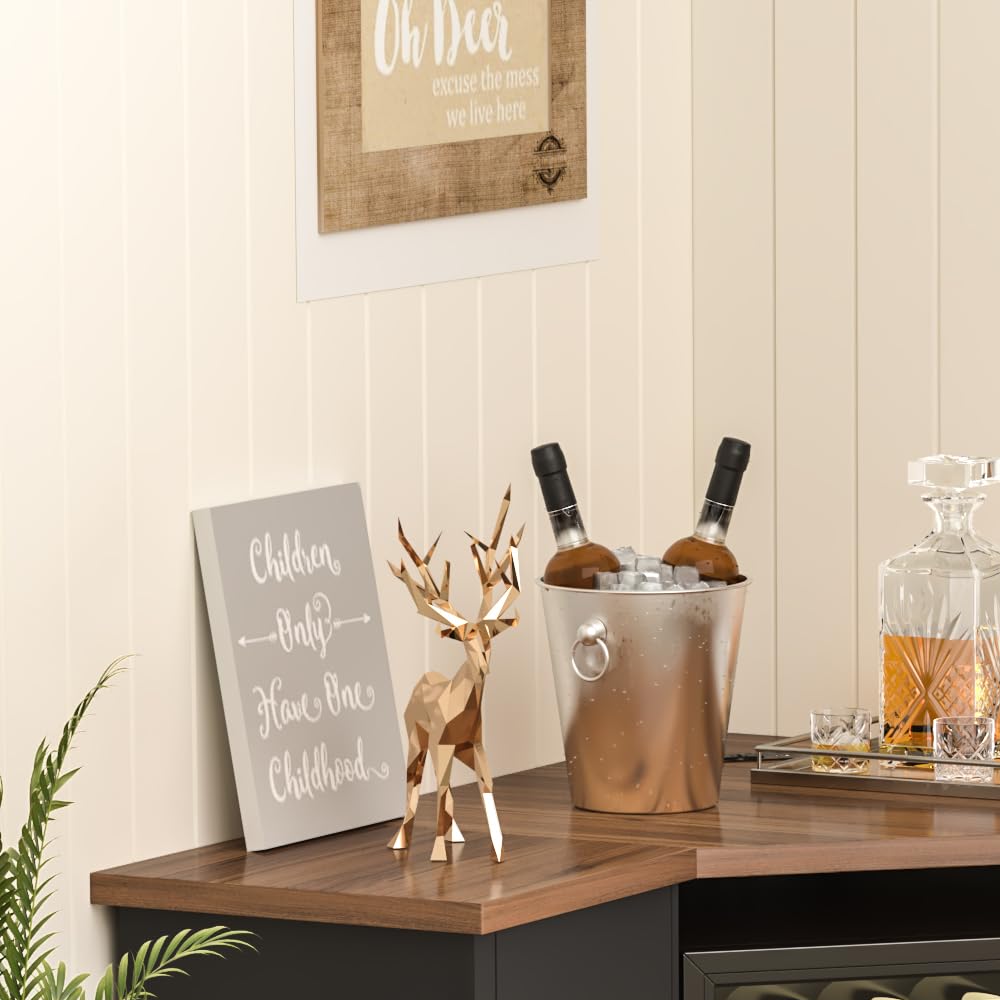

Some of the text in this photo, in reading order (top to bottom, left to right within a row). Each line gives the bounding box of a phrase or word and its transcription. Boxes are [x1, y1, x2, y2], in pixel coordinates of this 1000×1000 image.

[374, 0, 512, 75] Oh Deer
[432, 64, 540, 97] excuse the mess
[446, 97, 527, 128] we live here
[249, 528, 341, 584] Children
[276, 592, 332, 659] Only
[252, 671, 375, 739] Have One
[269, 736, 390, 802] Childhood
